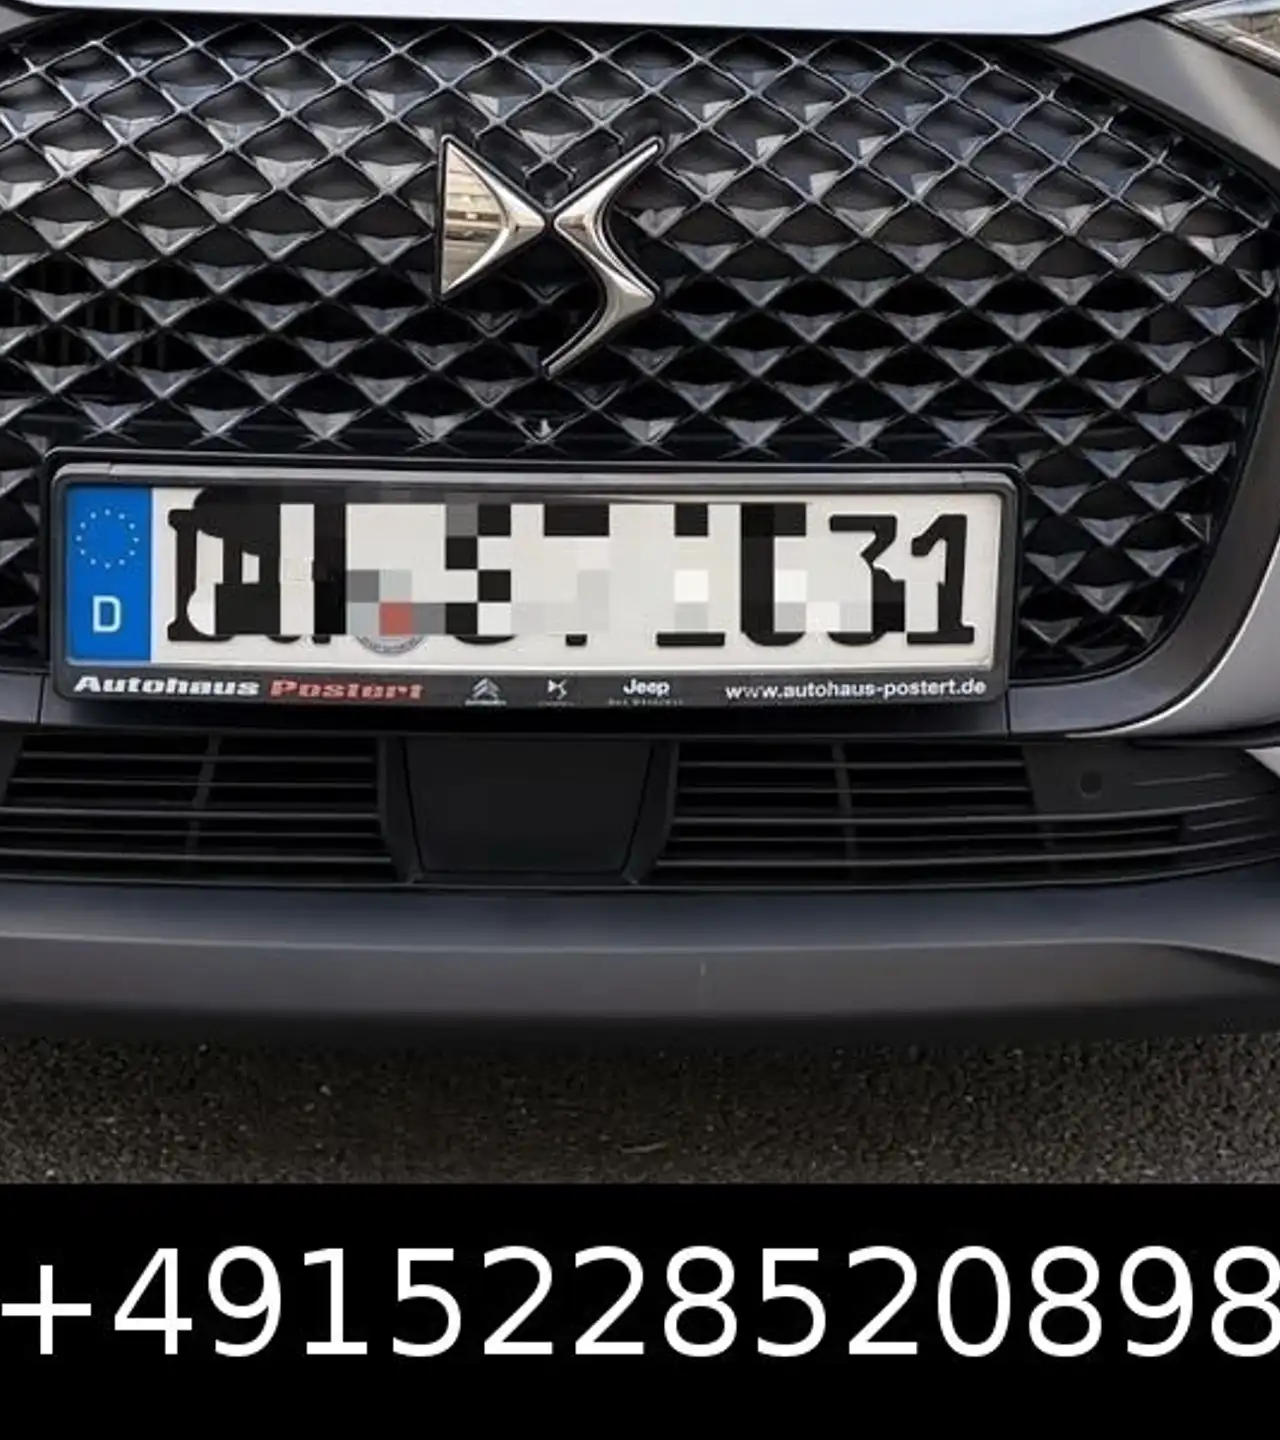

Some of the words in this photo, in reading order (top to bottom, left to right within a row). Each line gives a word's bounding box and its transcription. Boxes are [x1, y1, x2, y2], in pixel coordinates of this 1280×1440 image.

[92, 595, 121, 633] D
[74, 675, 260, 697] Autohaus
[270, 677, 424, 699] Postert
[623, 678, 670, 697] Jeep
[725, 677, 988, 700] www.autohaus-postert.de
